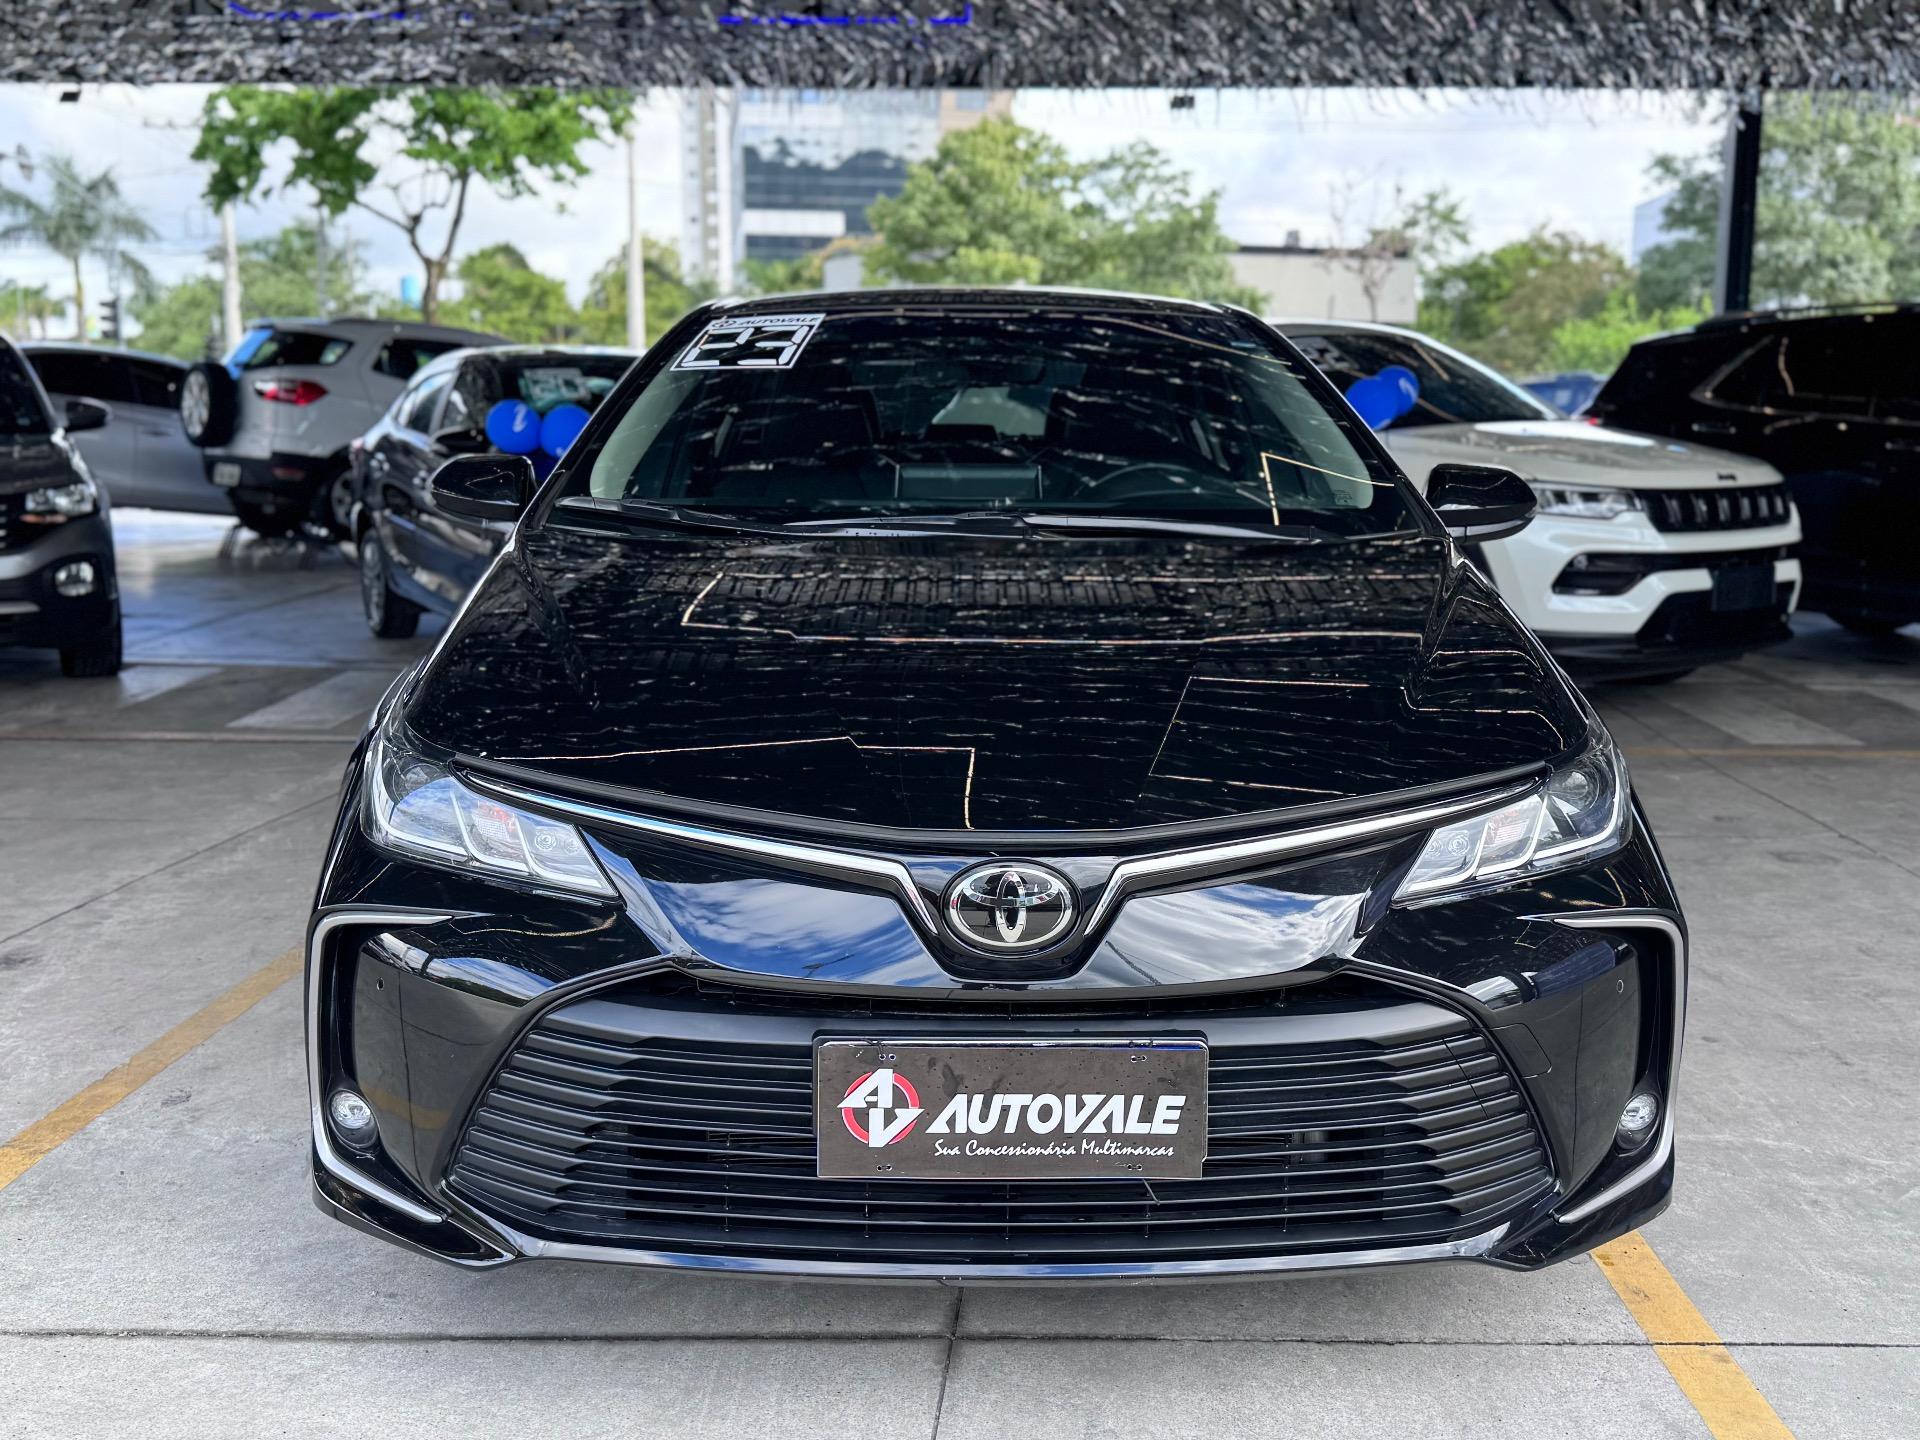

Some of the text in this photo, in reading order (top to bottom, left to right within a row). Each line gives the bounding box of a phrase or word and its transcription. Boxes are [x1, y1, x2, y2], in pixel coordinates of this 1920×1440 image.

[681, 326, 810, 367] 23
[925, 1093, 1186, 1135] AUTOVALE
[934, 1138, 1174, 1157] Sua Concessionária Multimarcas
